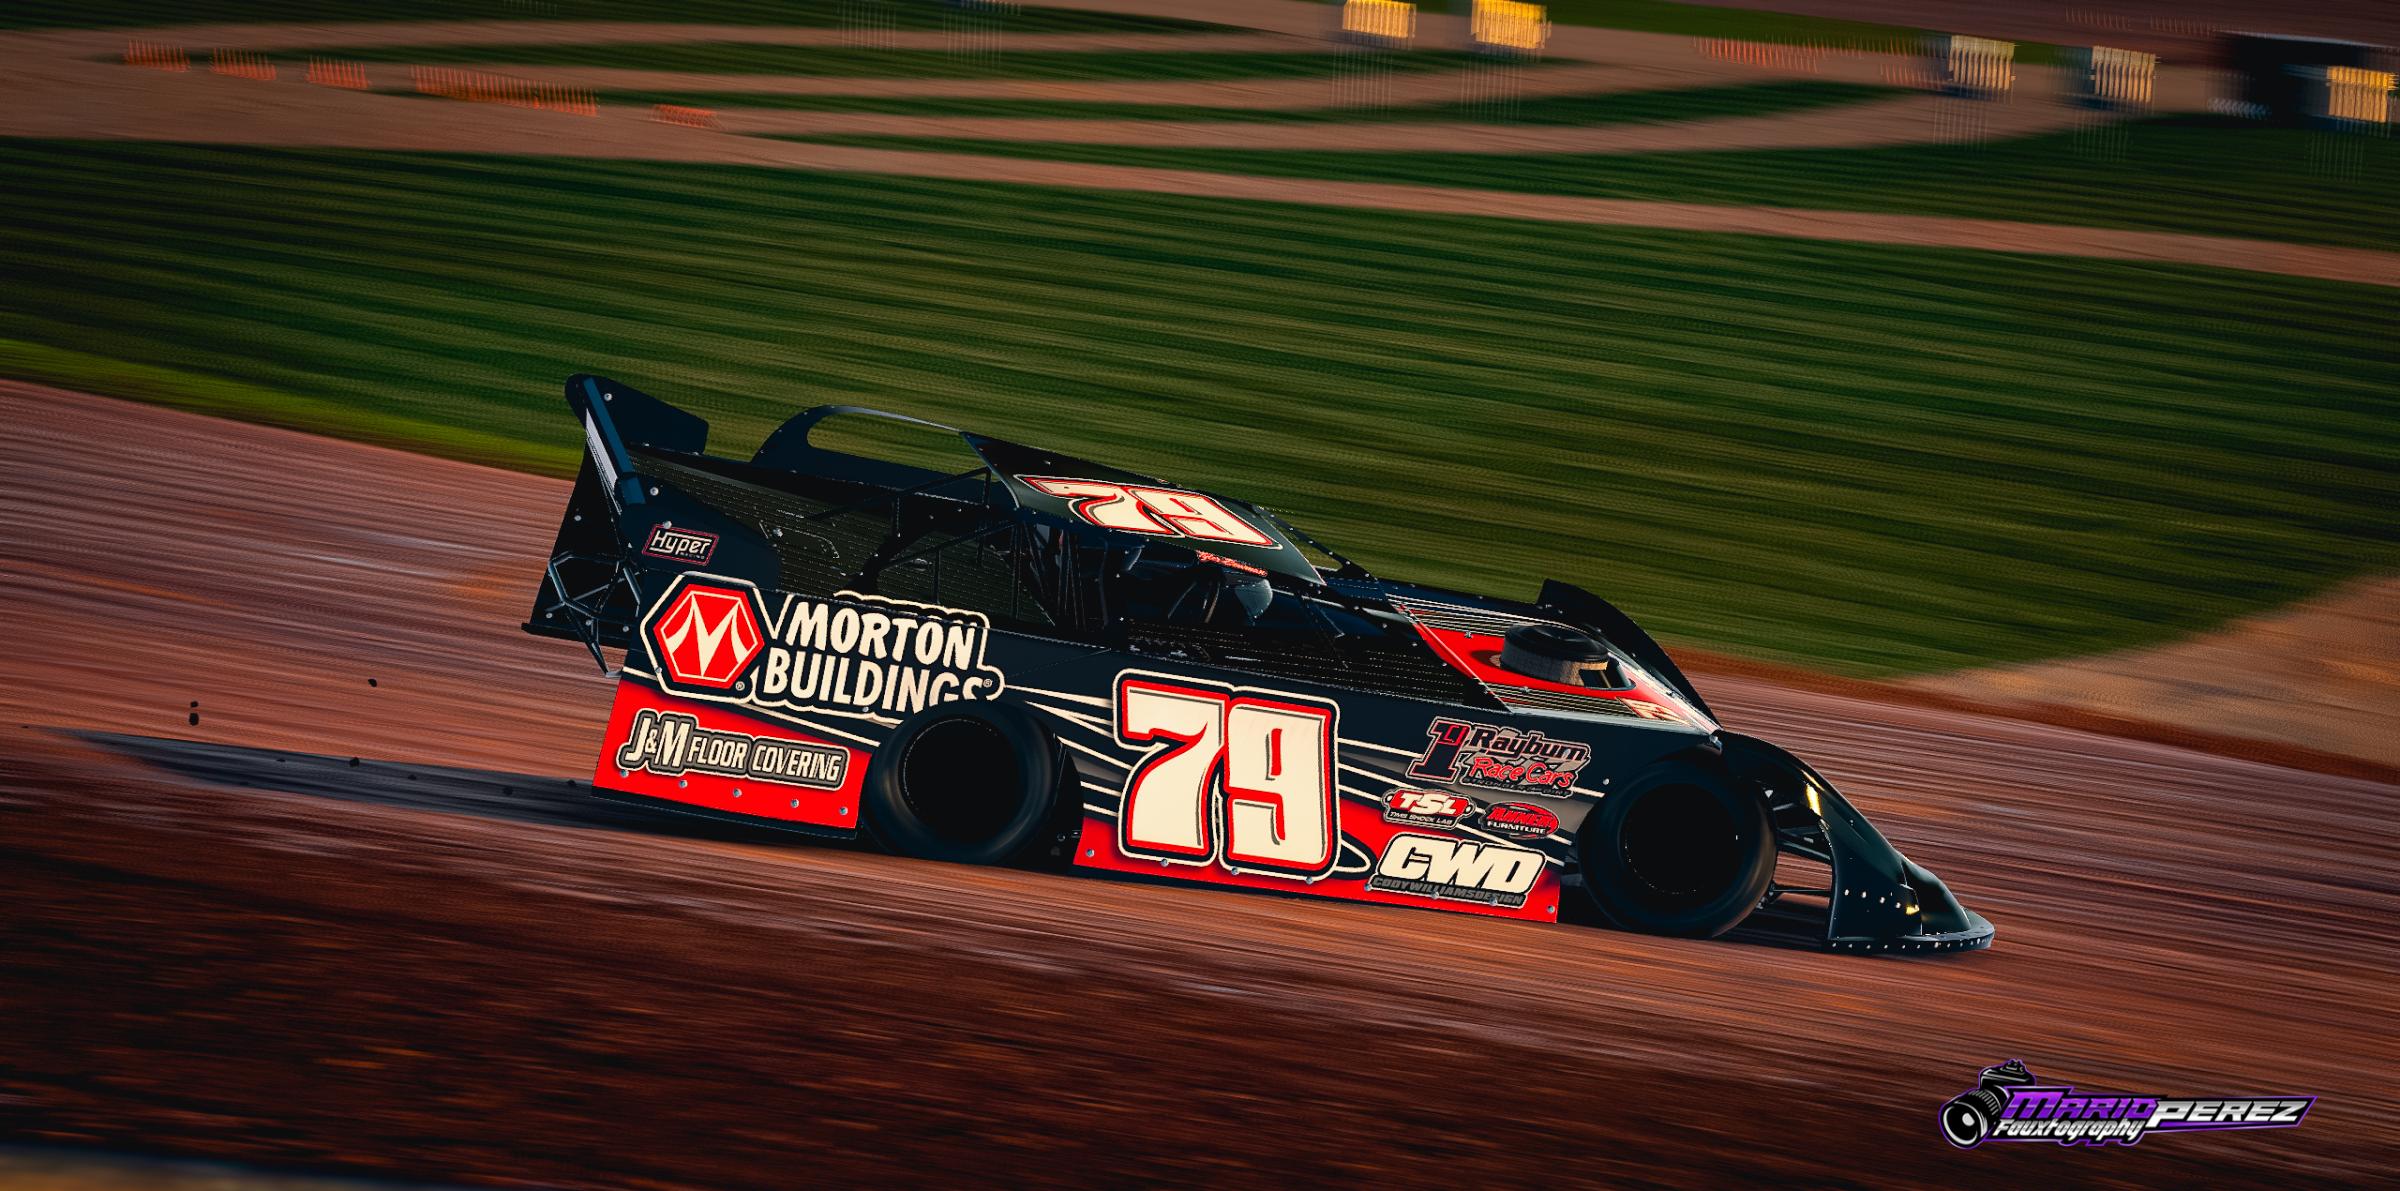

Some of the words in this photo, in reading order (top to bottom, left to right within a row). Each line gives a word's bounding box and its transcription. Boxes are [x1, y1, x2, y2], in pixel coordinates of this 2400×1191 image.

[1018, 476, 1278, 548] 79
[650, 530, 713, 555] Hyper
[785, 601, 977, 670] MORTON
[624, 717, 690, 768] J&M
[686, 736, 748, 769] FLOOR
[752, 745, 842, 780] COVERING
[1469, 728, 1589, 761] Rayburn
[1119, 676, 1335, 874] 79
[1469, 757, 1524, 780] Race
[1526, 762, 1575, 788] Cars
[1400, 792, 1458, 815] TSL
[1487, 820, 1547, 834] FURNITURE
[1379, 836, 1544, 893] CWD
[1373, 877, 1524, 904] CODYWILLIAMSDESIGN
